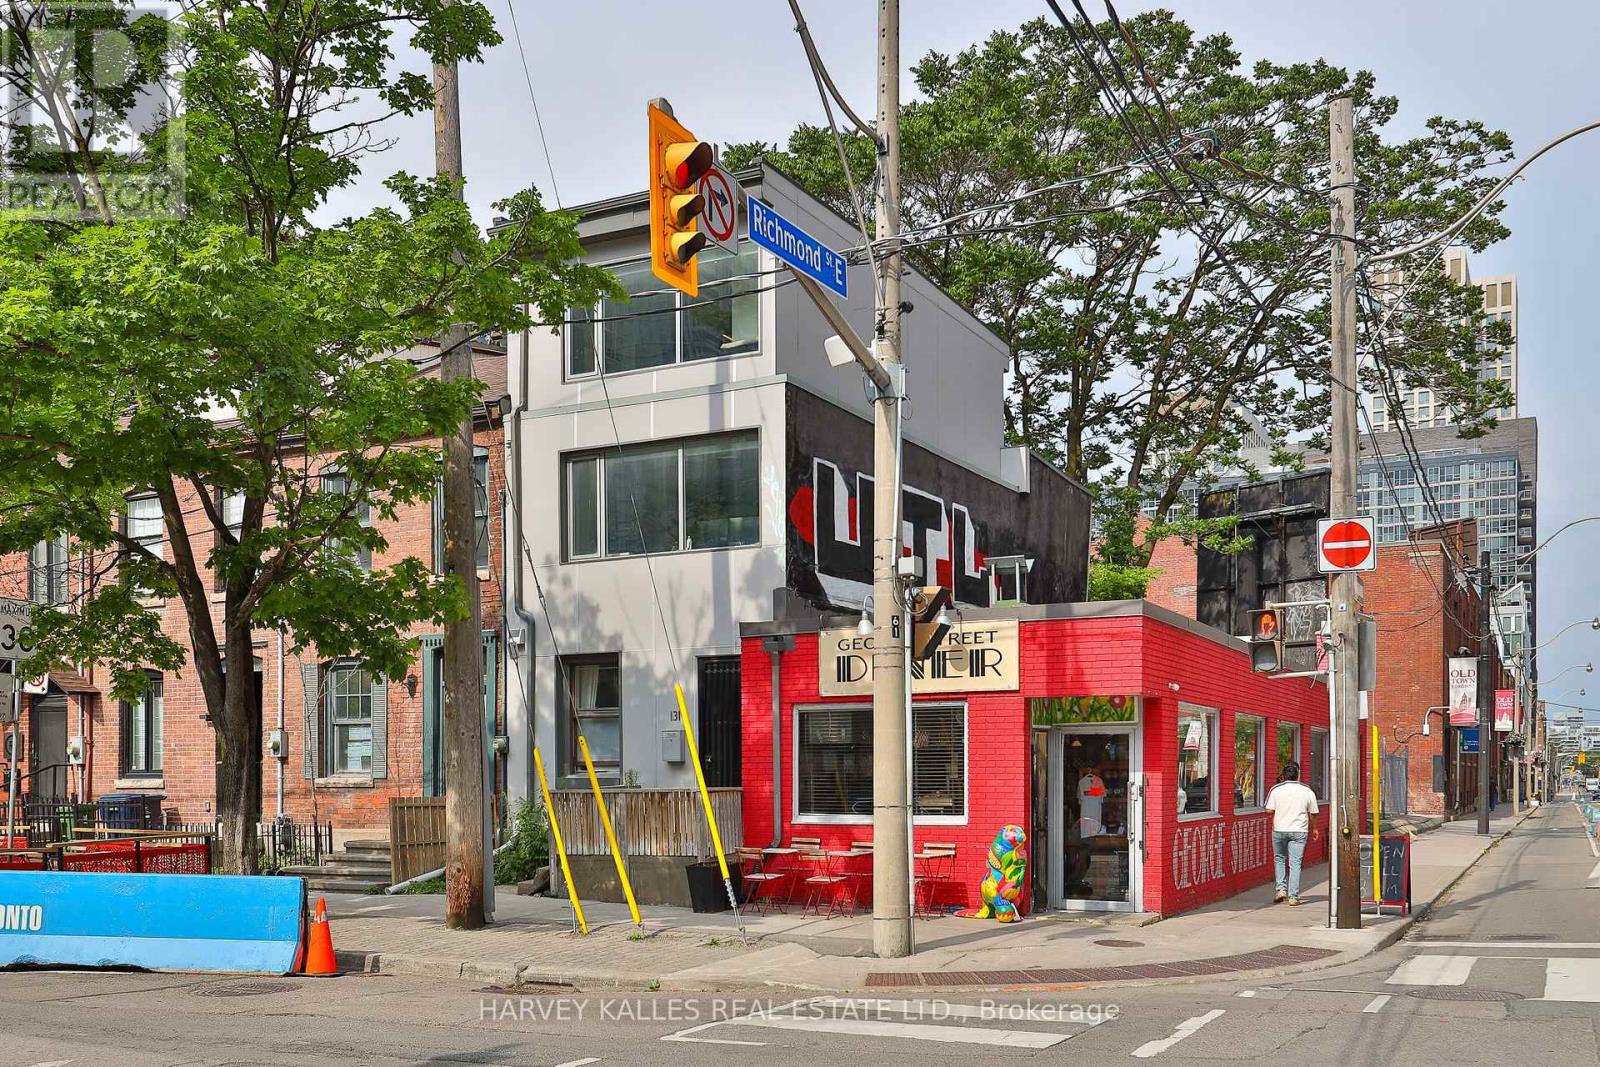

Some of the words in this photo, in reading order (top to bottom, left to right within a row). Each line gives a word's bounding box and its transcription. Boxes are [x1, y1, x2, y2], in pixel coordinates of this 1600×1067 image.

[753, 203, 821, 272] Richmond
[835, 258, 843, 285] E
[1451, 669, 1475, 678] OLD
[1172, 822, 1225, 890] GEORGE
[1231, 817, 1268, 875] STREET
